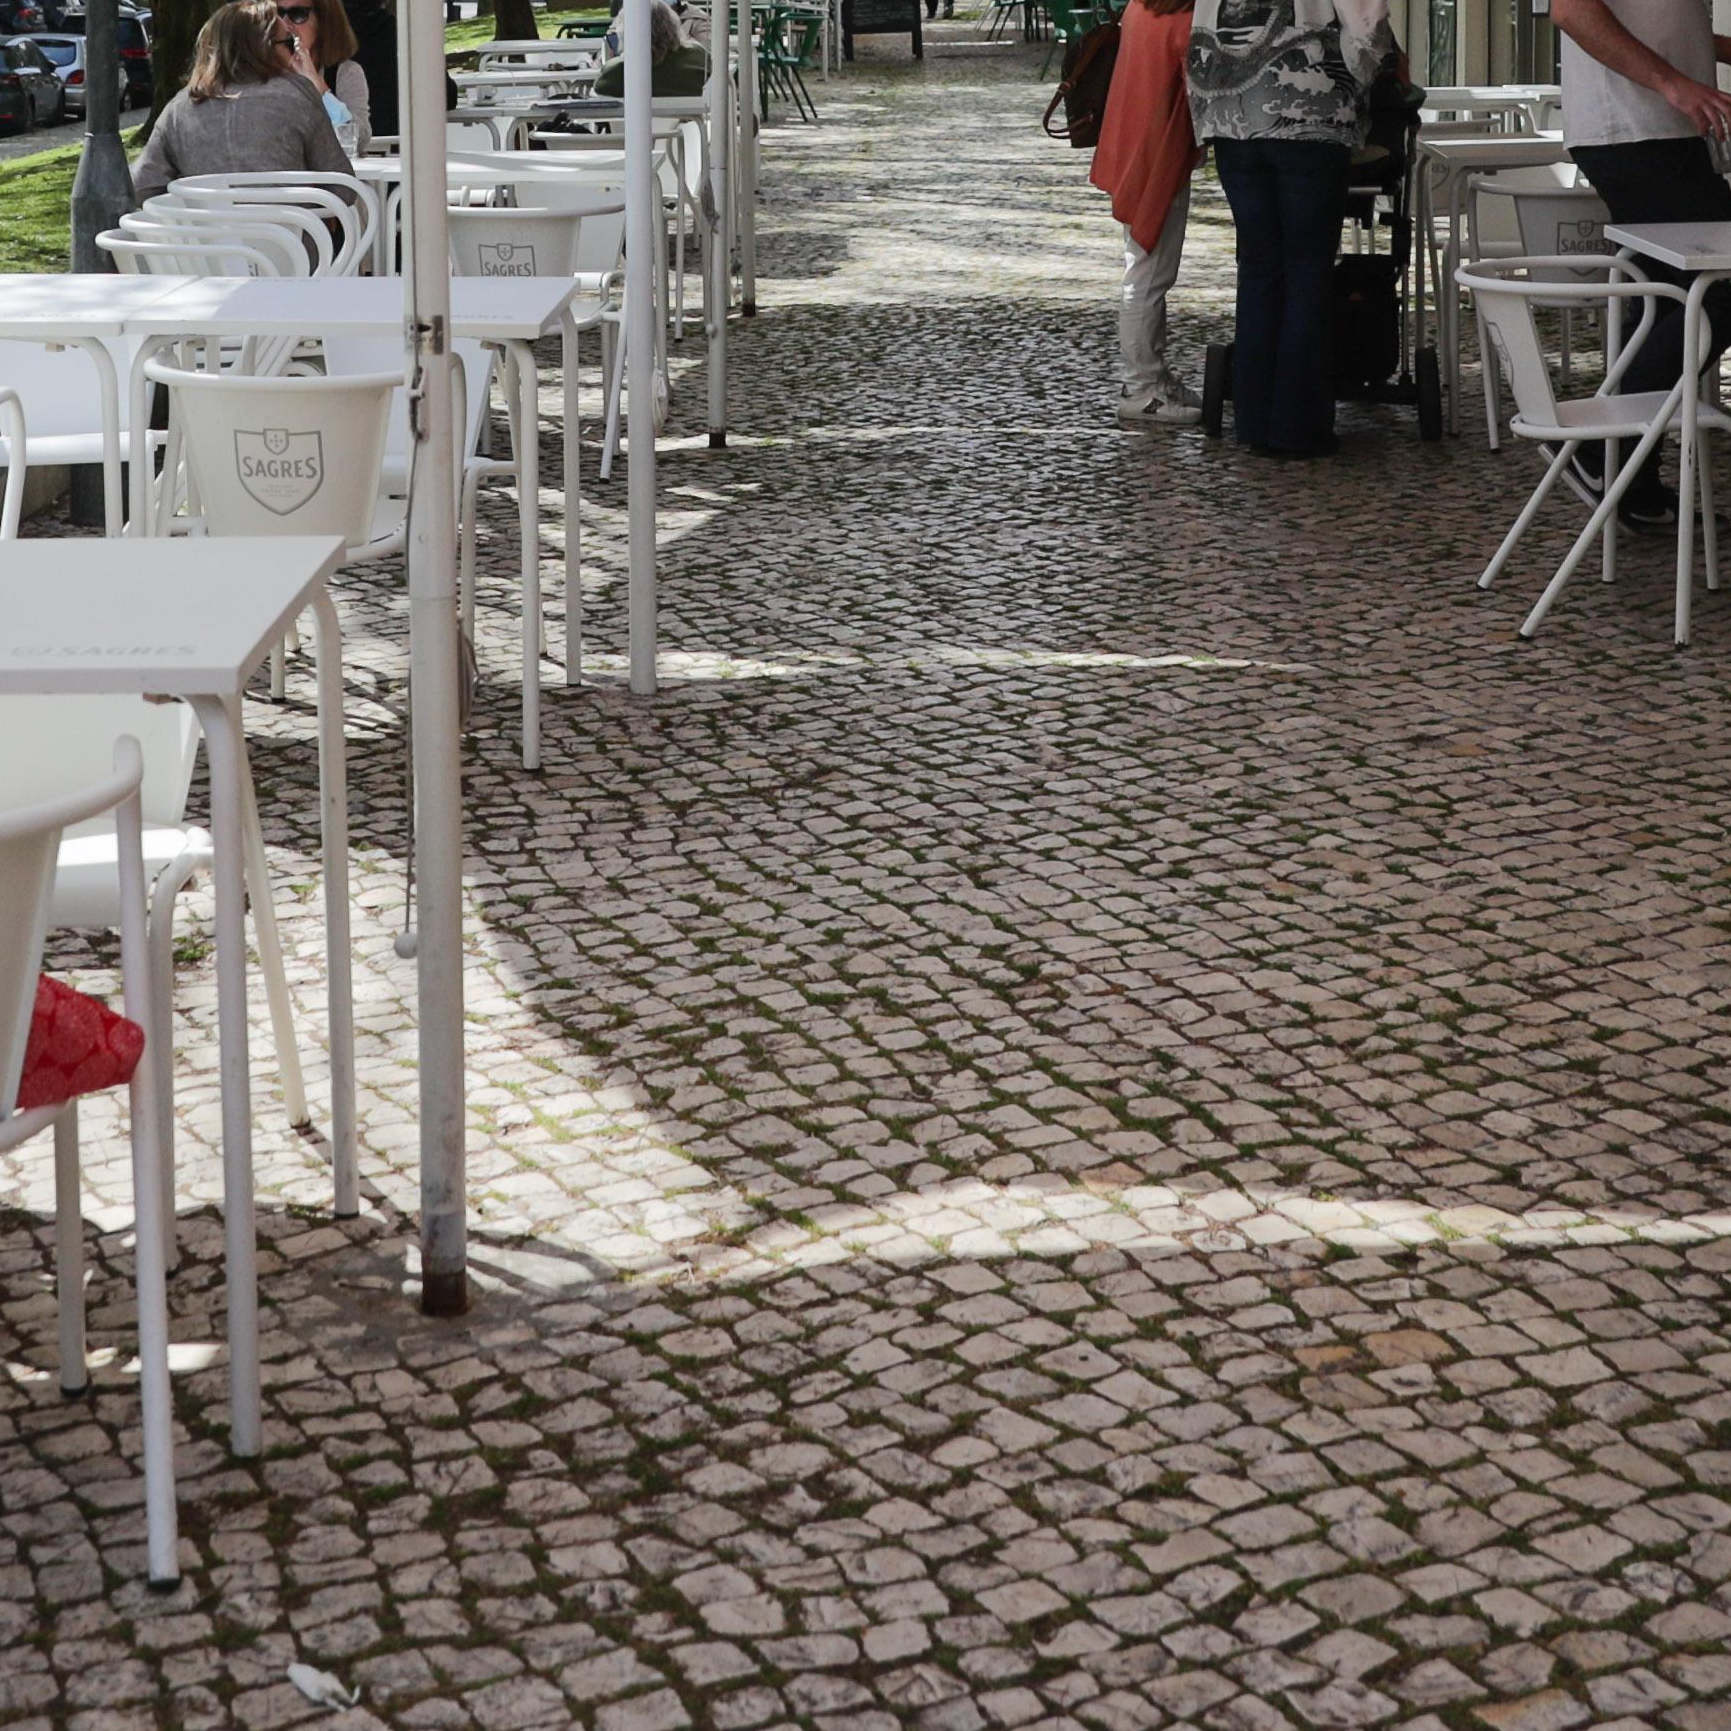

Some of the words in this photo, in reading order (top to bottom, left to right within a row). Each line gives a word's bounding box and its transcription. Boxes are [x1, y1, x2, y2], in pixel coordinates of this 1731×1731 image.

[1561, 238, 1608, 253] SAGRES
[484, 262, 532, 277] SAGRES
[242, 456, 318, 479] SAGRES
